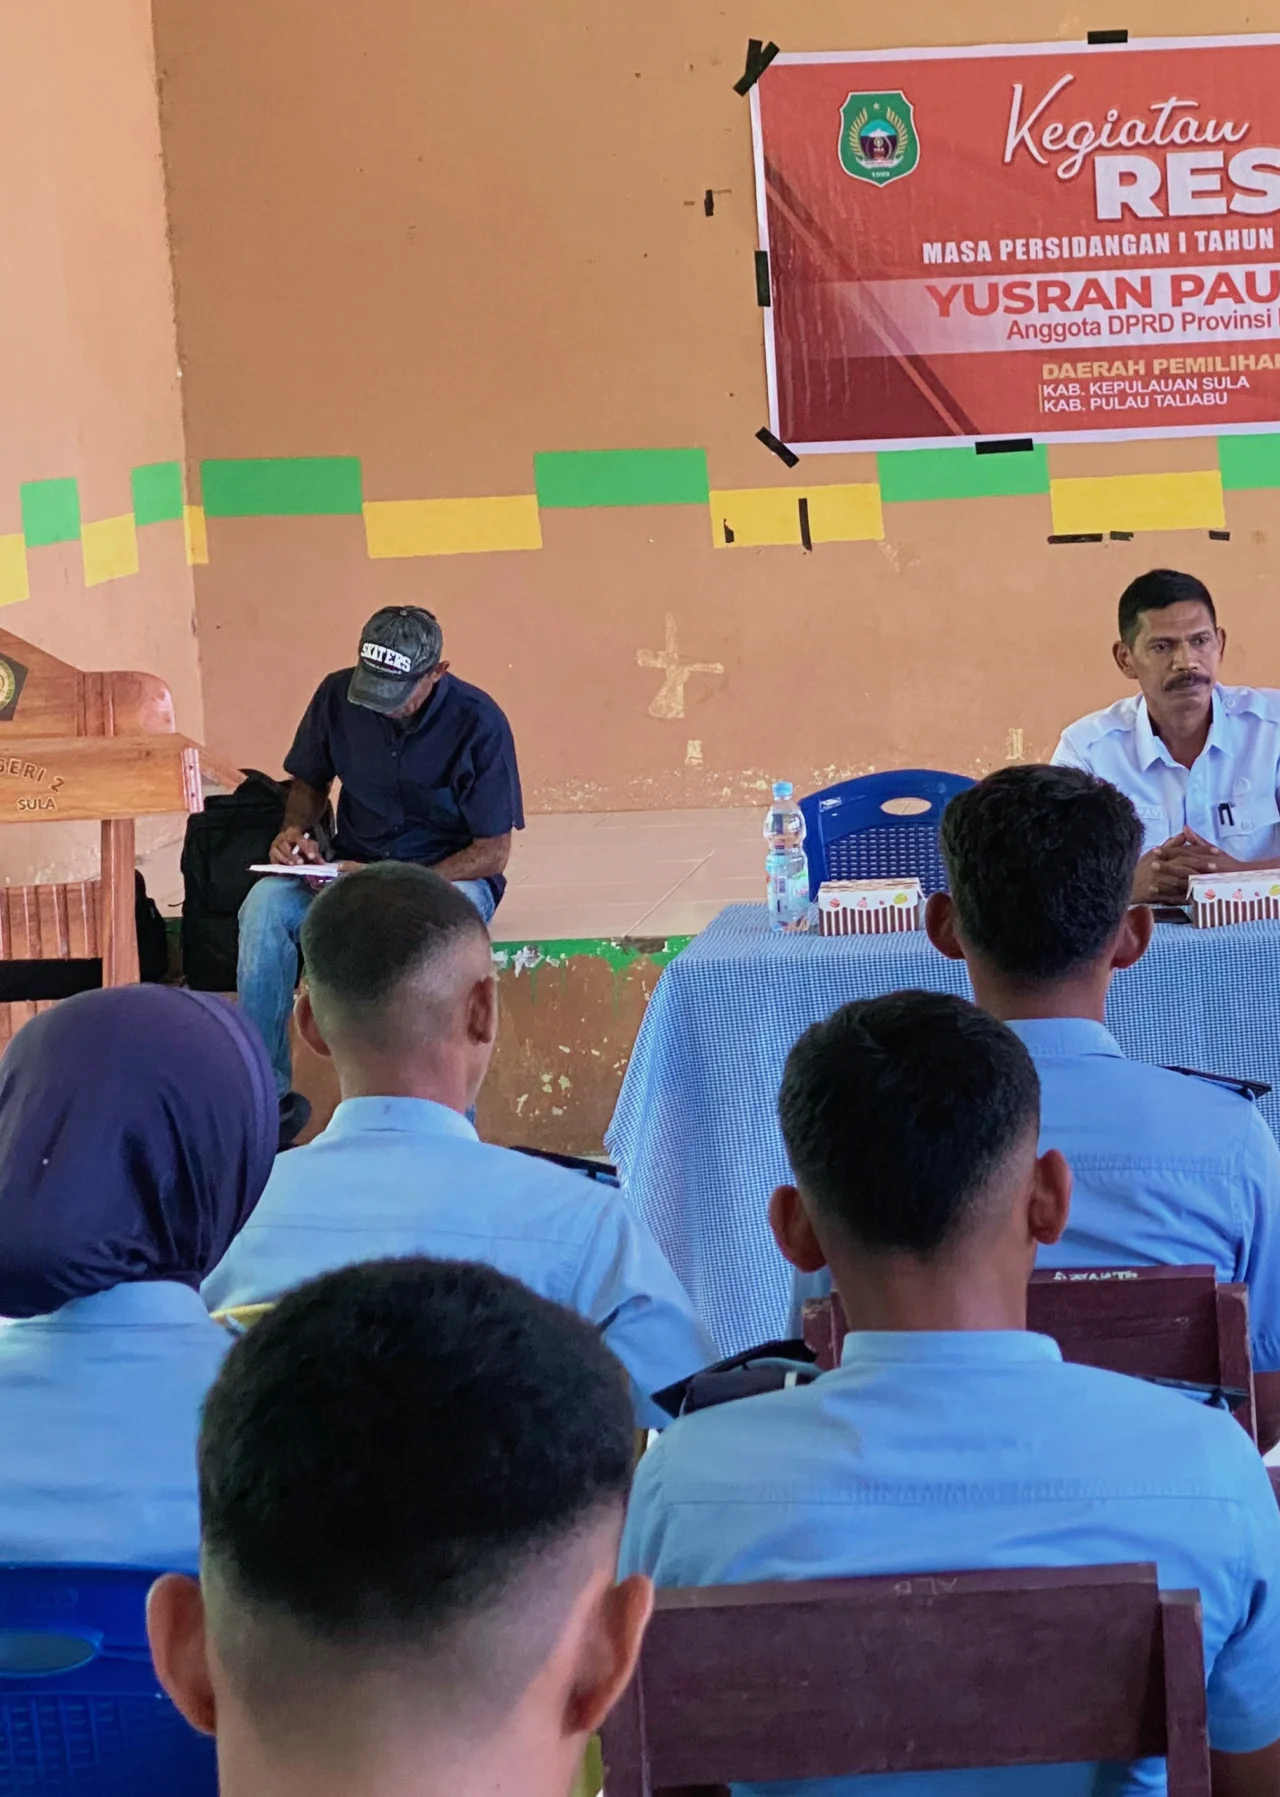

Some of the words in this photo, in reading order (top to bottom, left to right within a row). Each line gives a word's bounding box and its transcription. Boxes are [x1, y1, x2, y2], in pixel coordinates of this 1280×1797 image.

[922, 240, 992, 264] MASA
[999, 232, 1170, 261] PERSIDANGAN
[1179, 231, 1187, 253] I
[1194, 228, 1275, 252] TAHUN
[924, 275, 1153, 318] YUSRAN
[1006, 317, 1101, 344] Anggota
[1108, 313, 1175, 336] DPRD
[1181, 308, 1272, 332] Provinsi
[1041, 359, 1146, 380] DAERAH
[1042, 383, 1086, 397] KAB.
[1089, 378, 1199, 395] KEPULAUAN
[1201, 375, 1250, 390] SULA
[1043, 397, 1087, 412] KAB.
[1090, 395, 1150, 411] PULAU
[1153, 391, 1229, 409] TALIABU
[360, 642, 412, 673] SKATERS
[50, 776, 66, 793] 2
[17, 797, 57, 812] SULA
